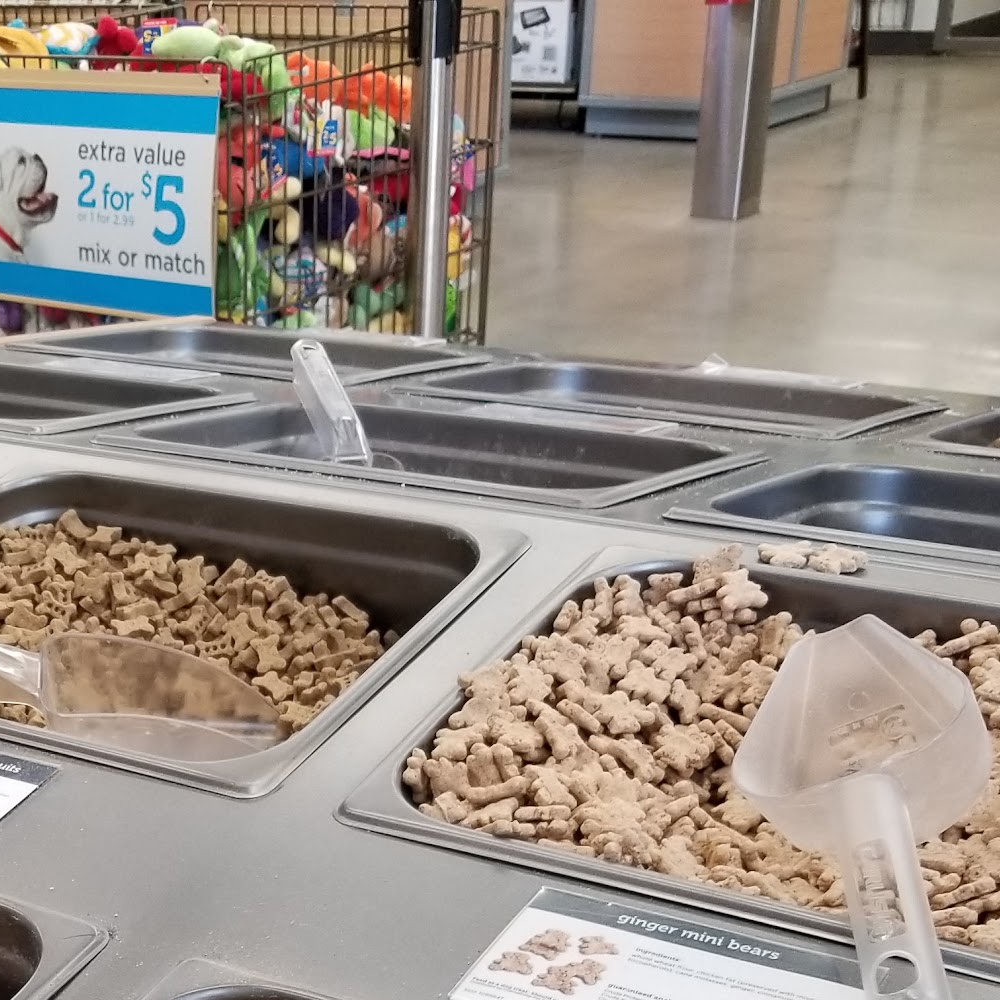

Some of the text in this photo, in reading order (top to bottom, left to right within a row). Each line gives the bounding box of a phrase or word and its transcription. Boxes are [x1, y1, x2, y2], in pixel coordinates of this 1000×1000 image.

[78, 141, 186, 167] extra value
[77, 168, 96, 208] 2
[102, 182, 134, 212] for
[79, 243, 206, 276] mix or match
[616, 914, 780, 960] ginger mini bears
